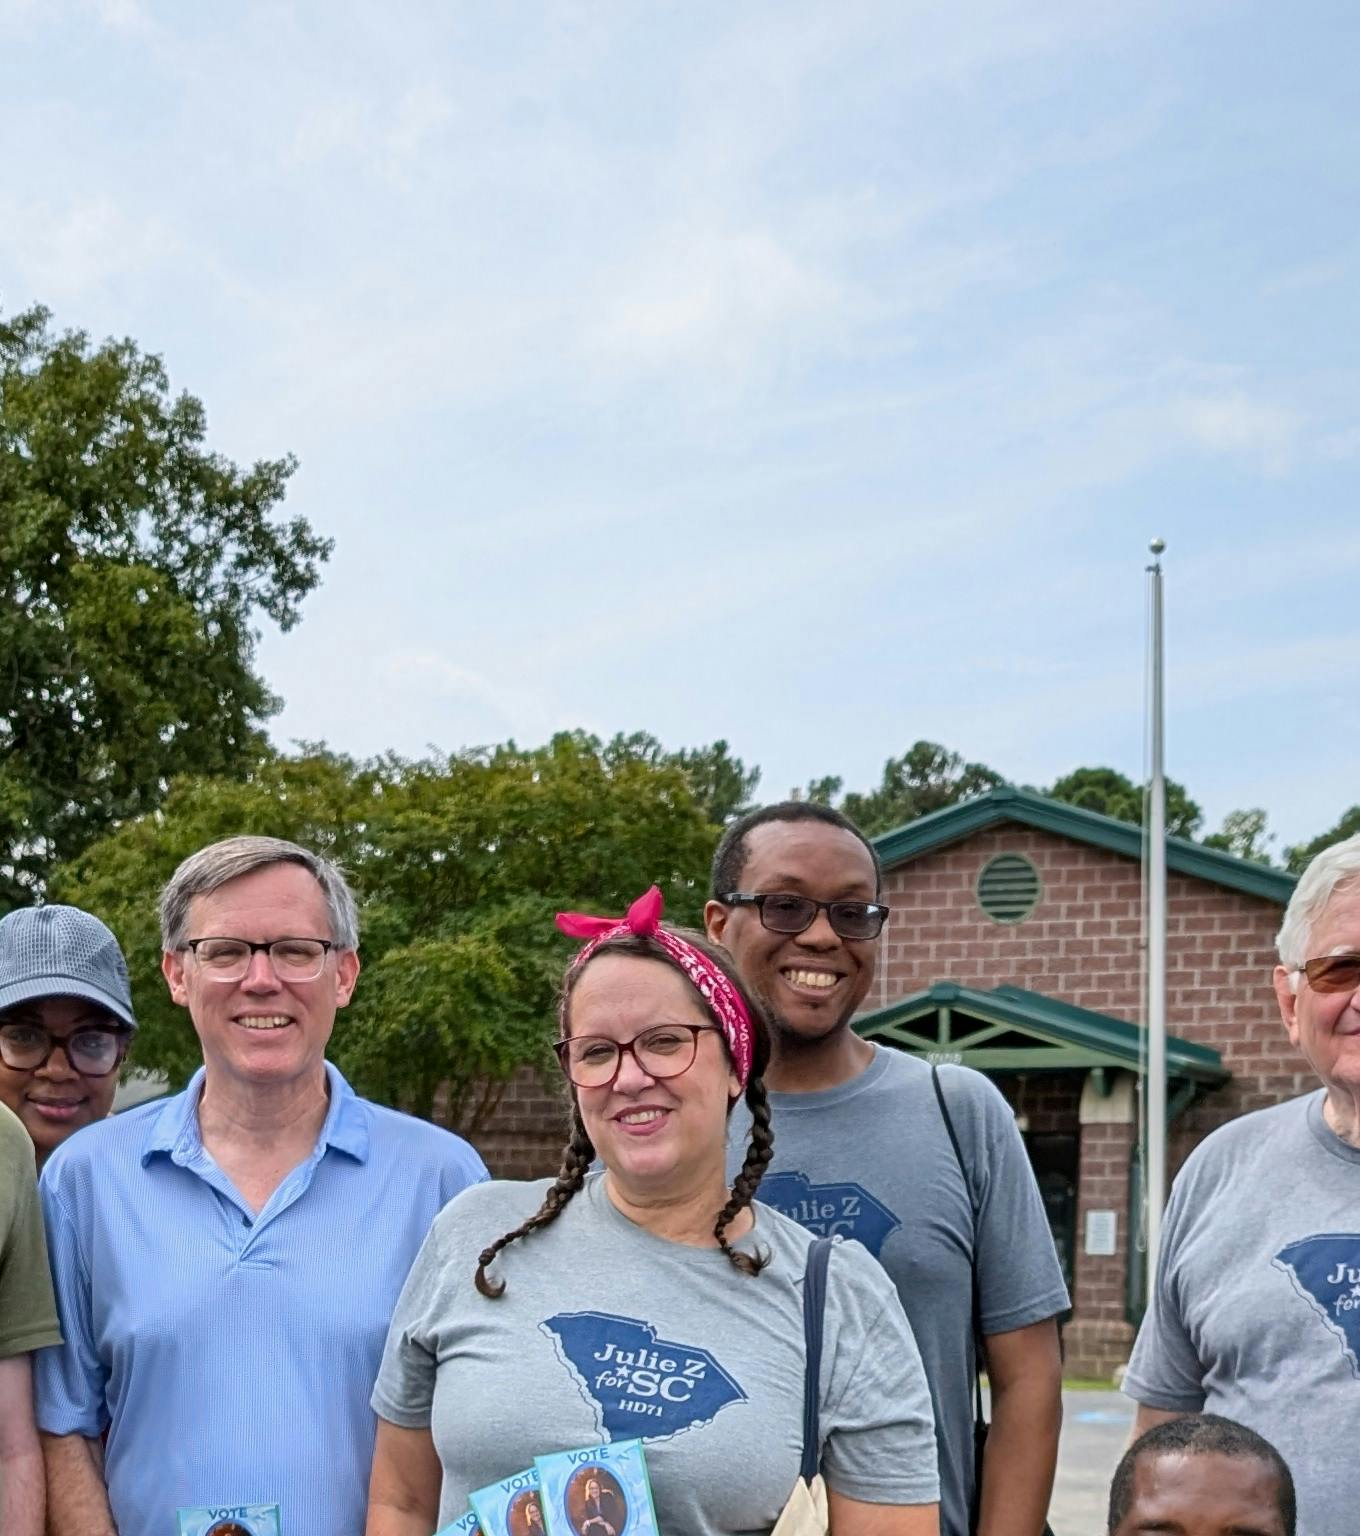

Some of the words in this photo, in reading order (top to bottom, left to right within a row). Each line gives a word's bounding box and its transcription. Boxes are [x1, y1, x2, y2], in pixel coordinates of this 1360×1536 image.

[772, 1200, 836, 1221] ulie
[842, 1197, 860, 1216] Z
[593, 1343, 677, 1373] Julie
[682, 1358, 707, 1379] Z
[595, 1370, 629, 1389] for
[627, 1370, 695, 1402] SC
[618, 1399, 664, 1417] HD71
[567, 1447, 610, 1465] VOTE
[500, 1469, 539, 1494] VOTE
[208, 1507, 249, 1520] VOTE
[456, 1513, 478, 1531] VO
